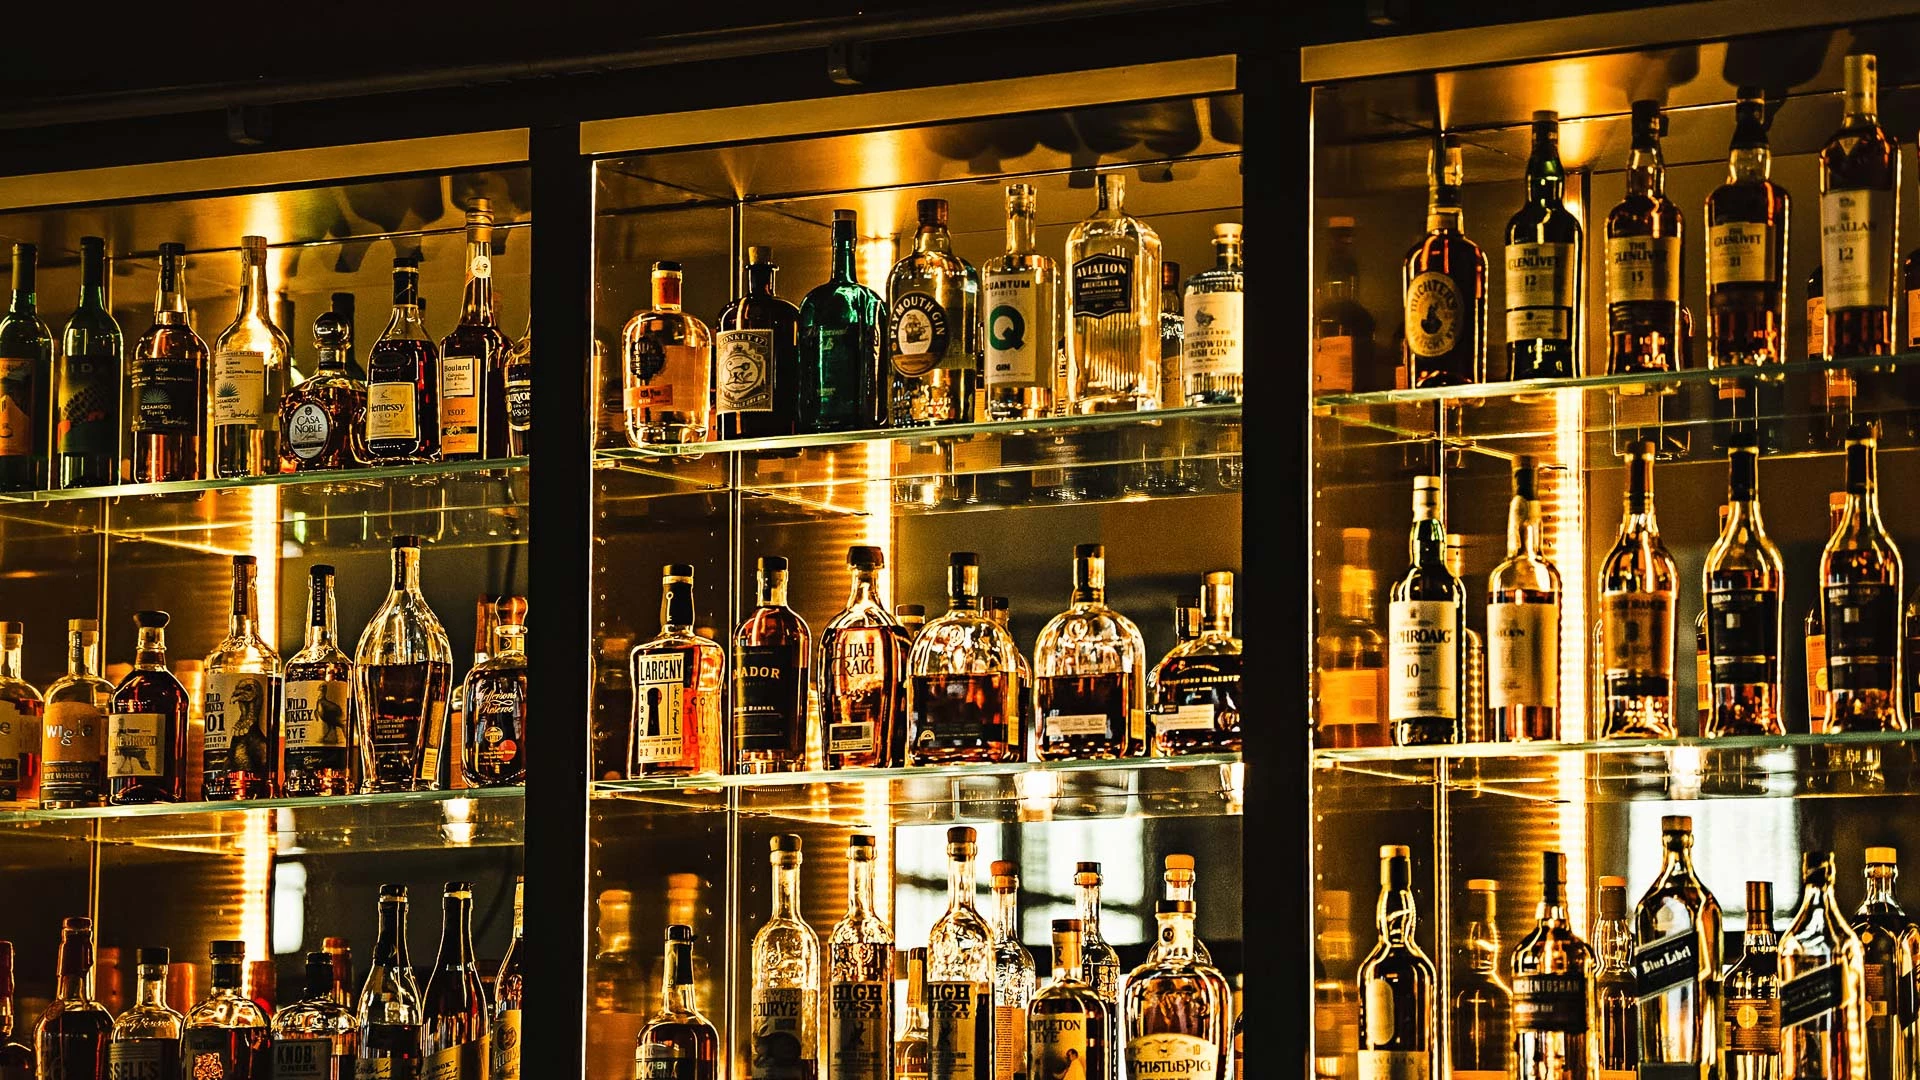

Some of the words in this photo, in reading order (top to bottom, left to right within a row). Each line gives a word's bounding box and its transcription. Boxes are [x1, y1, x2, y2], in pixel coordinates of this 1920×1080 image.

[1839, 247, 1853, 260] 12
[1076, 263, 1126, 278] AVIATION
[1632, 271, 1644, 281] 15
[1525, 275, 1536, 285] 12
[890, 296, 934, 339] PLYMOUTH
[990, 305, 1025, 350] Q
[369, 402, 406, 413] Hennessy
[297, 414, 320, 428] CASA
[294, 423, 323, 436] NOBLE
[640, 659, 682, 682] LARCENY
[1407, 664, 1419, 678] 10
[1202, 675, 1239, 683] RESERVE
[286, 698, 308, 710] WILD
[287, 727, 305, 739] RYE
[655, 746, 681, 756] PROOF
[55, 772, 90, 780] WHISKEY
[1642, 957, 1665, 975] Blue
[1664, 944, 1692, 966] Label
[832, 984, 882, 1001] HIGH
[832, 1001, 882, 1012] WEST
[1035, 1031, 1060, 1043] RYE
[278, 1046, 312, 1064] KNOB
